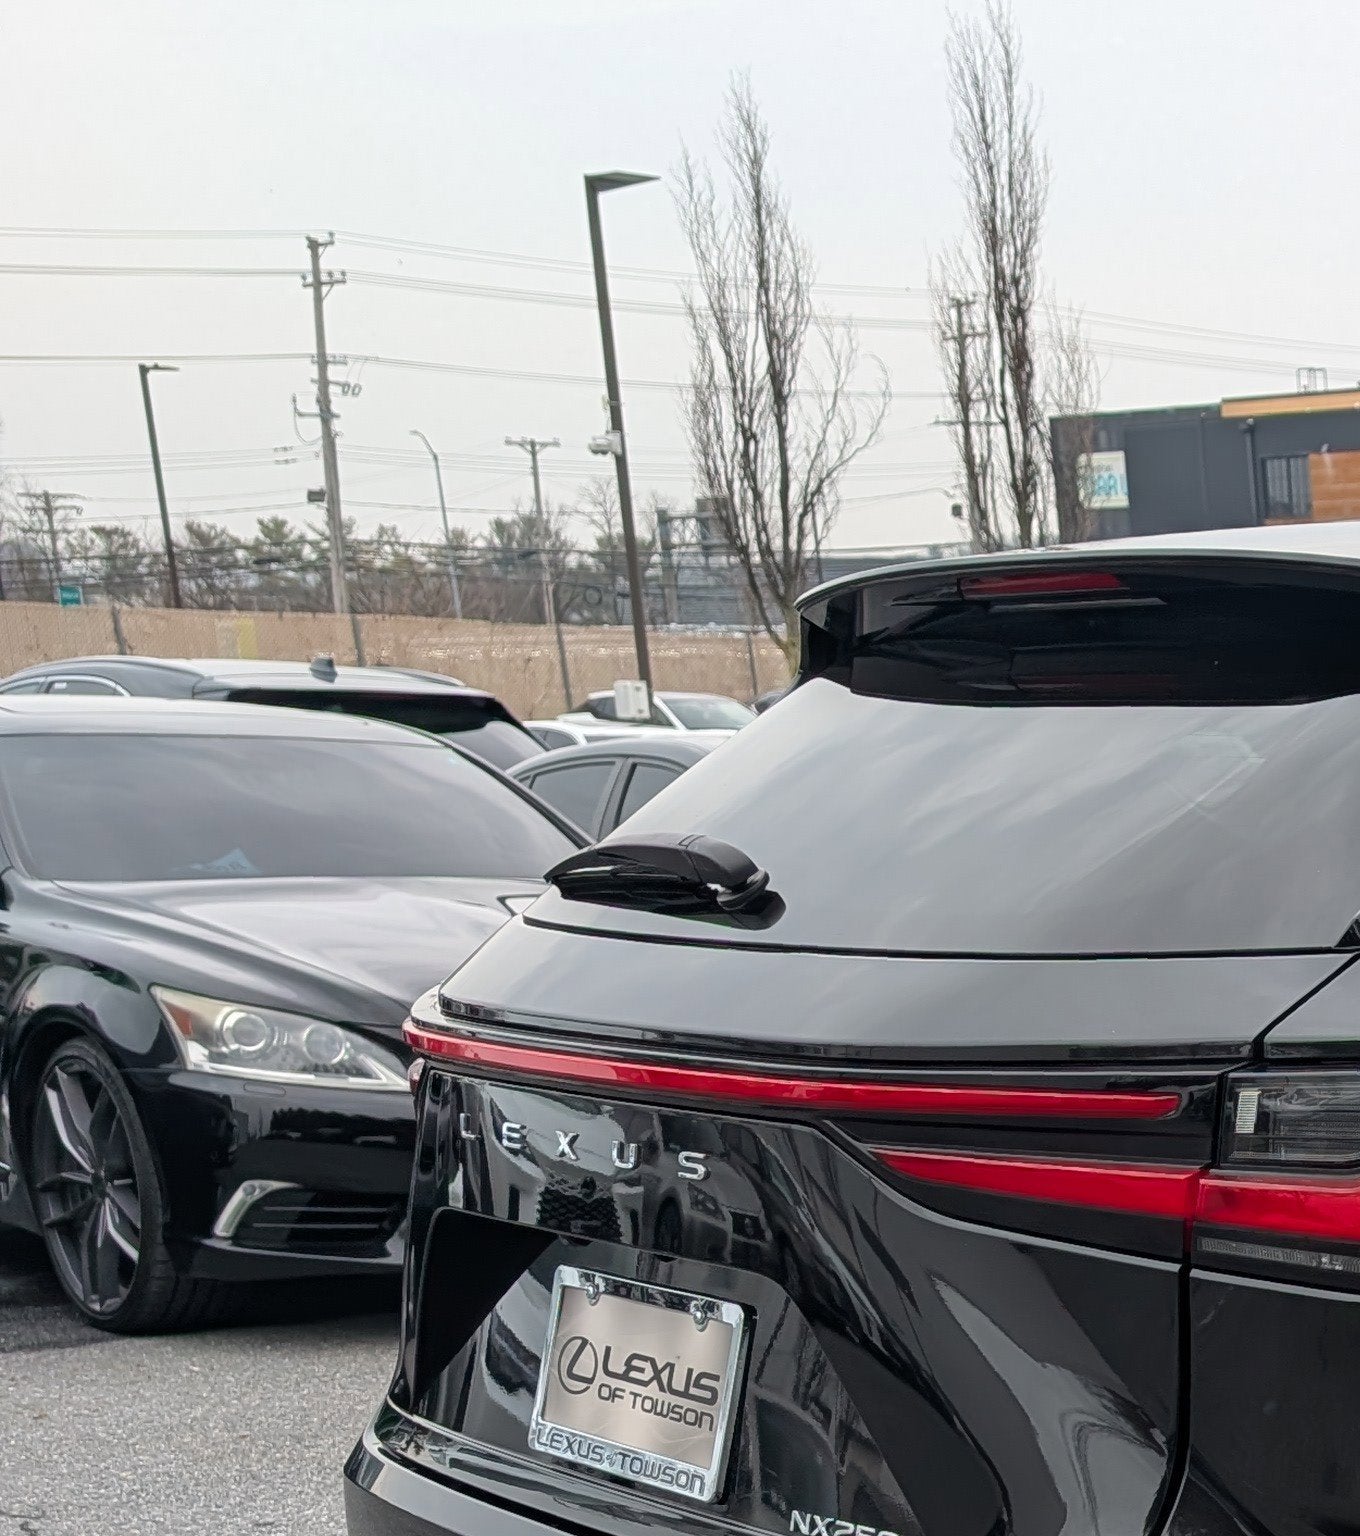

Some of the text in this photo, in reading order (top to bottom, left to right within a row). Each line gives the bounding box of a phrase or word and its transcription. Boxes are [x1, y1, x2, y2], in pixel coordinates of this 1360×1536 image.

[459, 1112, 708, 1181] LEXUS
[597, 1382, 715, 1432] OF TOWSON
[601, 1345, 721, 1407] LEXUS
[536, 1424, 606, 1465] LEXUS
[614, 1452, 706, 1496] TOWSON
